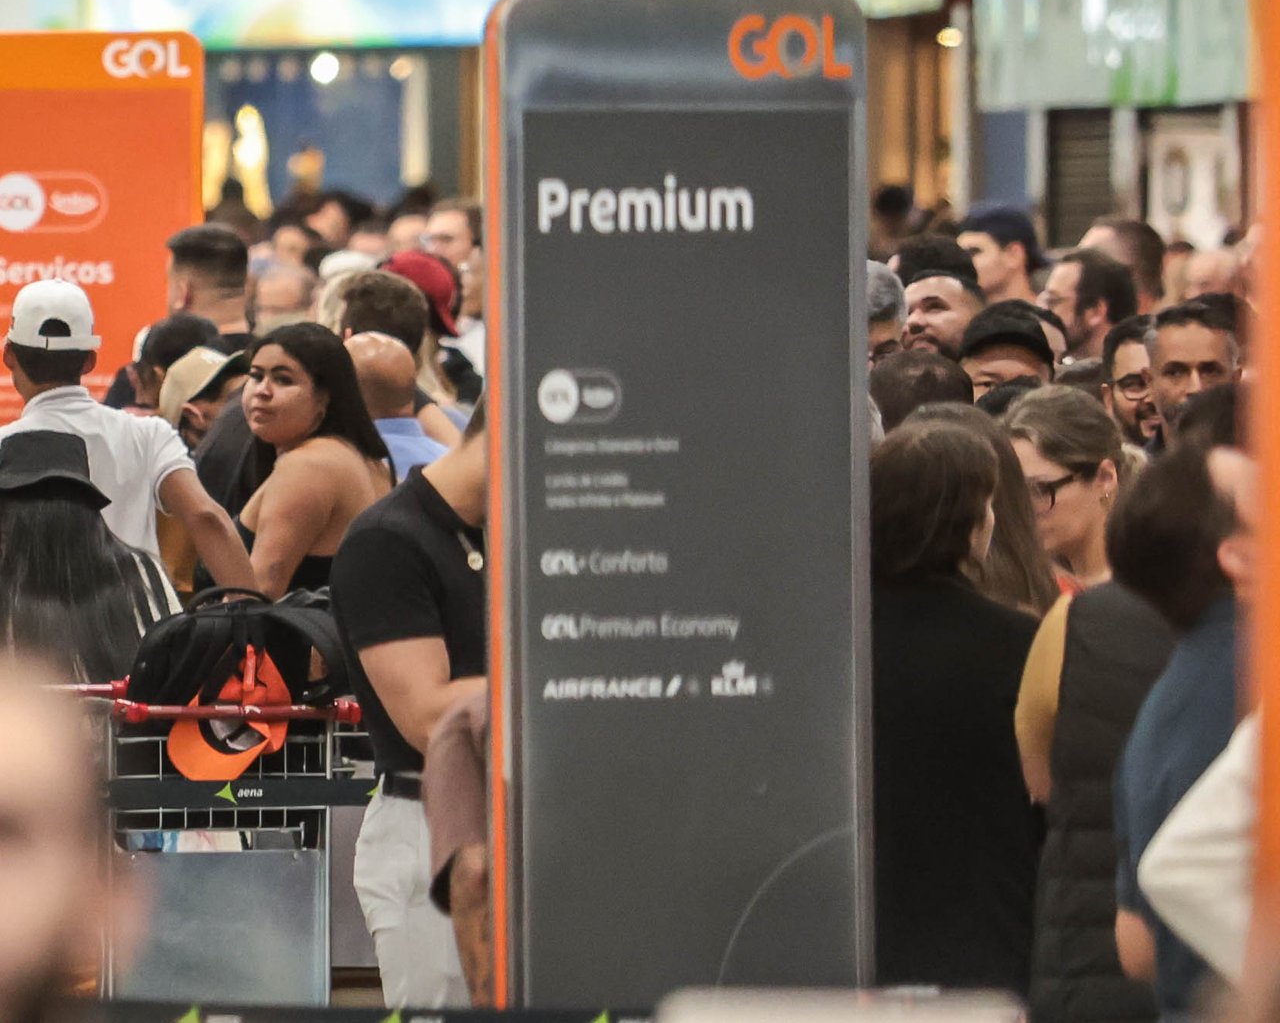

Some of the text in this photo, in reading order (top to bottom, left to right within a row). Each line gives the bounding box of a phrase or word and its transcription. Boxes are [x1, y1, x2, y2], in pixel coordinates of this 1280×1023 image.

[102, 39, 191, 78] GOL
[728, 14, 852, 79] GOL
[537, 175, 754, 233] Premium
[237, 787, 263, 798] aena
